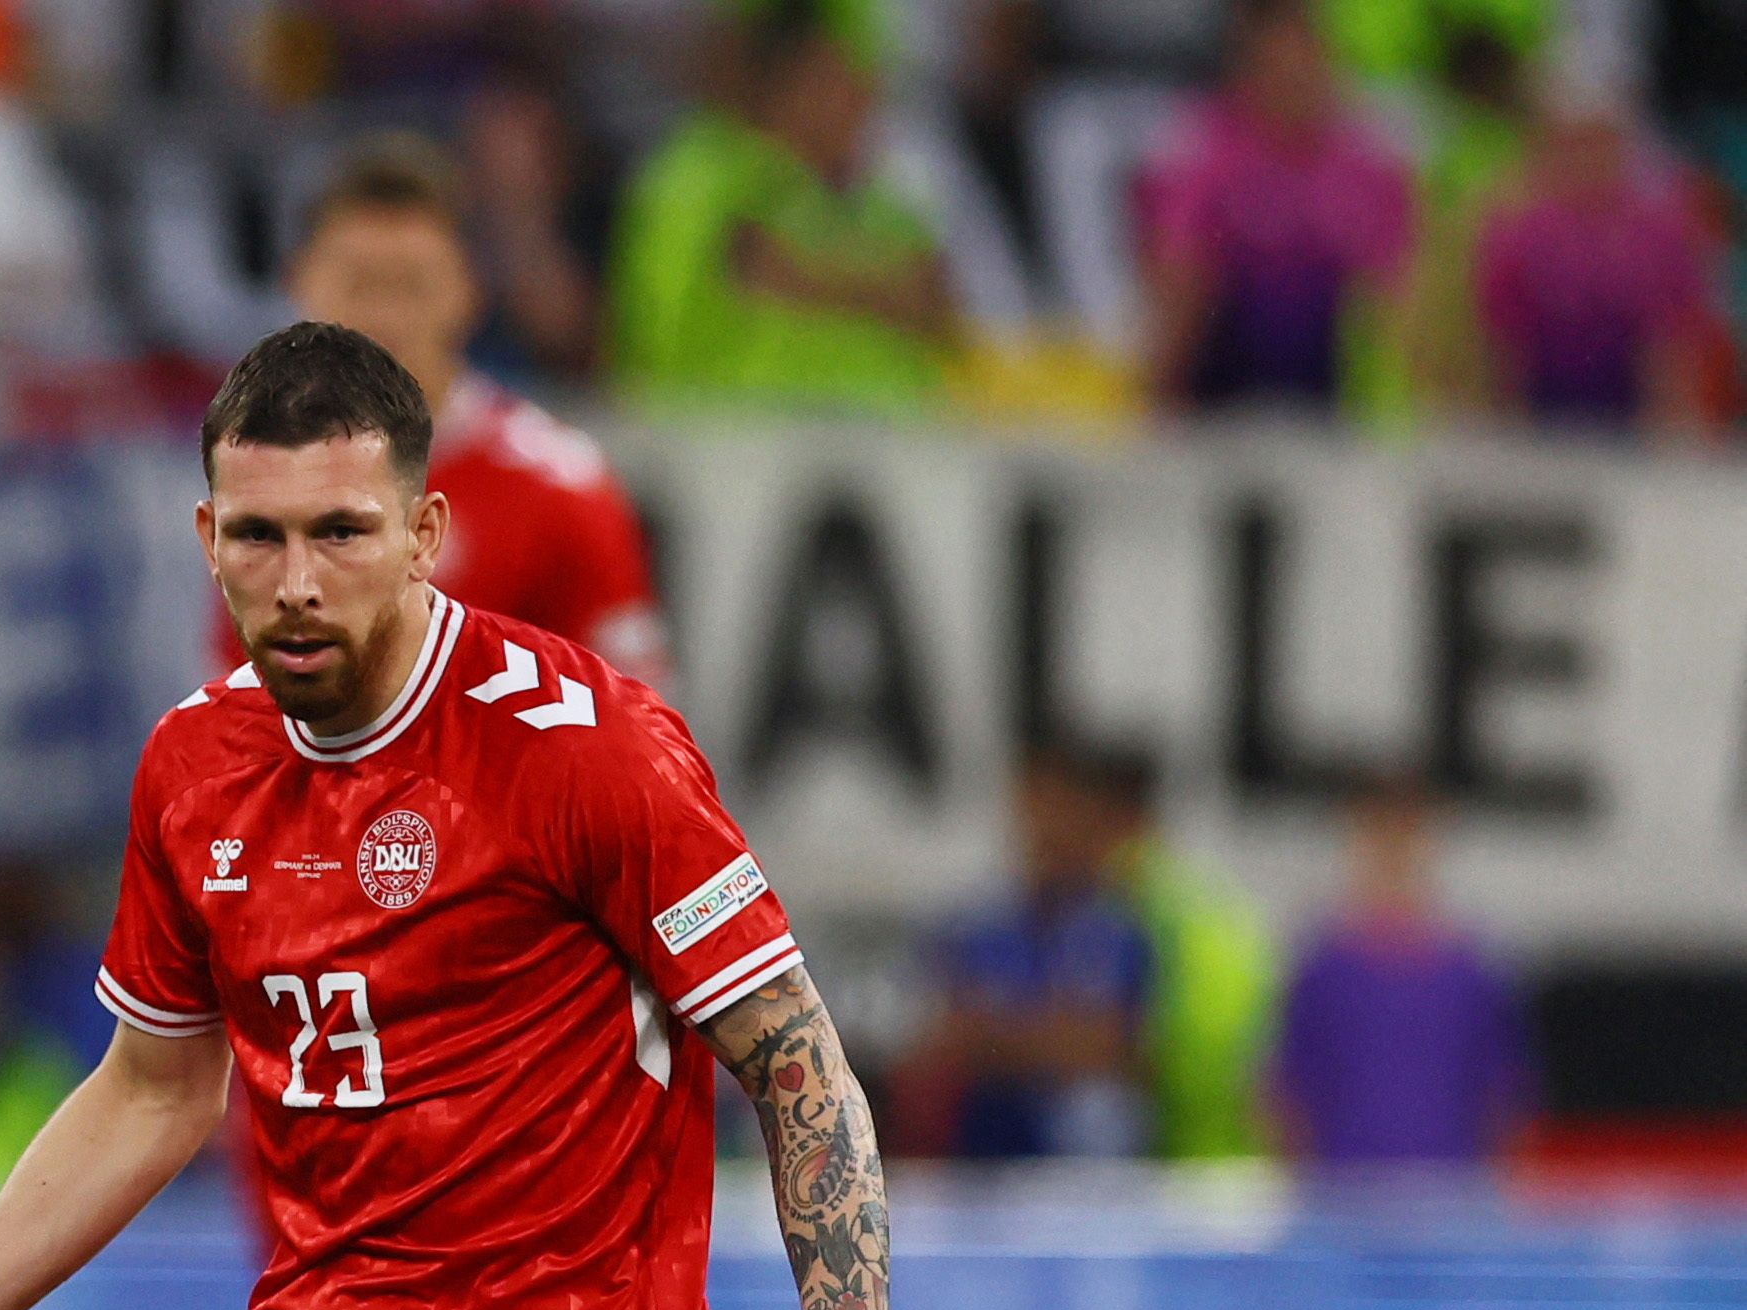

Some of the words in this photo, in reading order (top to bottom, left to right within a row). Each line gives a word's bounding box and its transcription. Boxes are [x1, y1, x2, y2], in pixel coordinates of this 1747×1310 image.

[360, 839, 378, 895] DANSK
[373, 842, 421, 872] DBU
[414, 840, 433, 892] UNION
[203, 874, 247, 892] hummel
[380, 891, 413, 905] 1889
[662, 865, 759, 942] FOUNDATION
[657, 907, 683, 929] UEFA
[262, 971, 386, 1108] 23
